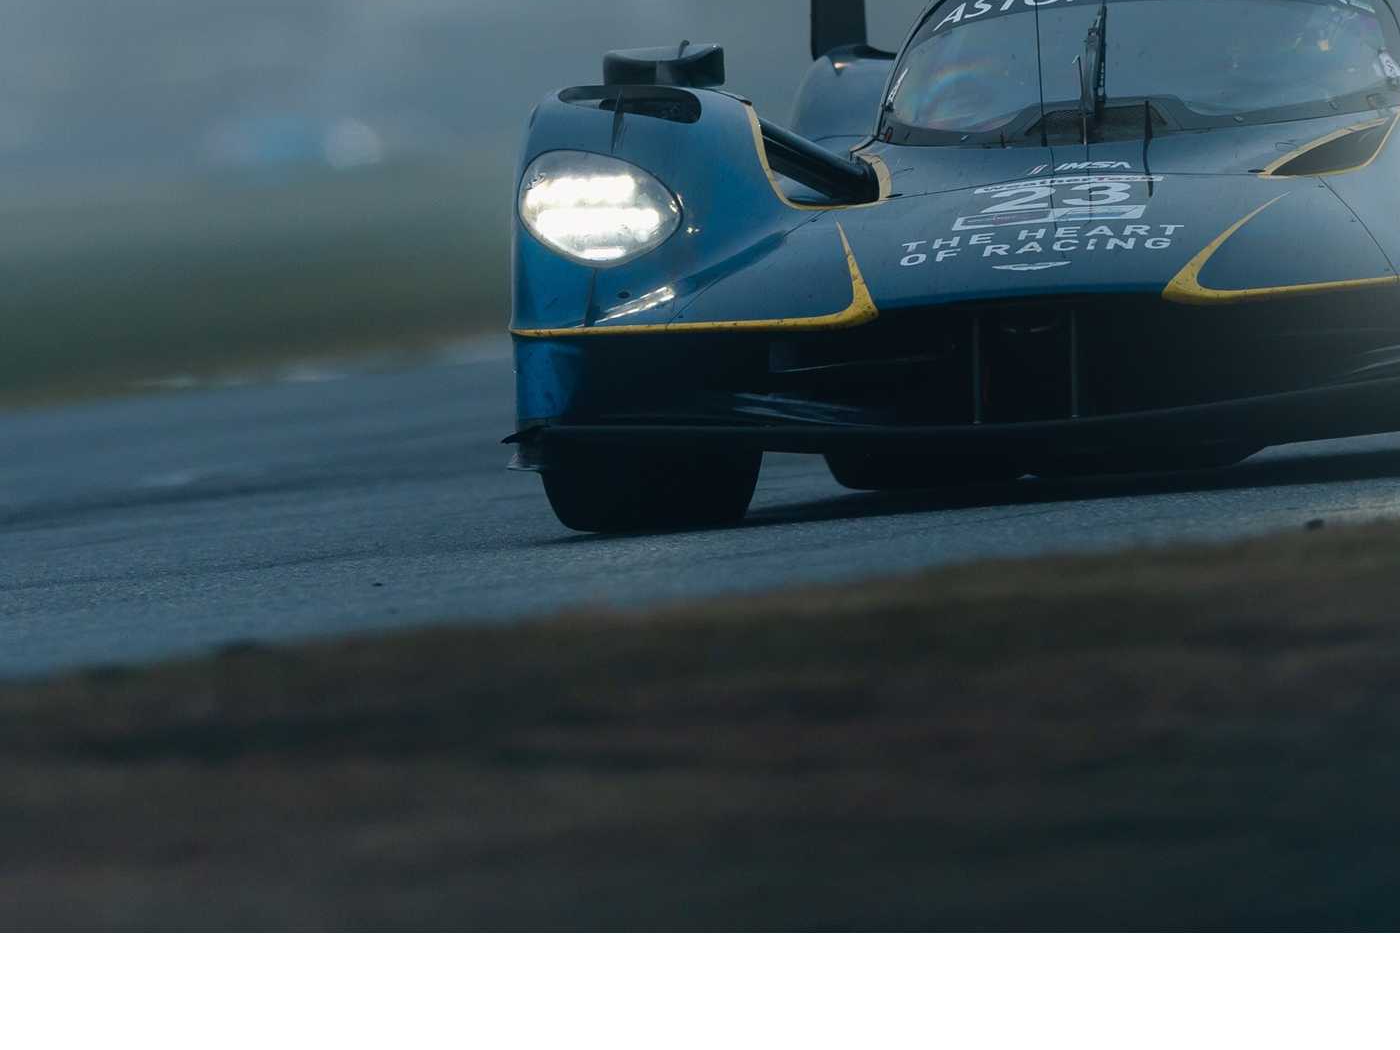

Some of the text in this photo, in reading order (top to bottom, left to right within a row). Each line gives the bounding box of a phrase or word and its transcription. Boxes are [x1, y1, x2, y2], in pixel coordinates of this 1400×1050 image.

[1054, 161, 1132, 172] IMSA
[980, 182, 1131, 214] 23
[900, 237, 1172, 267] OF RACING
[901, 224, 1185, 253] THE HEART
